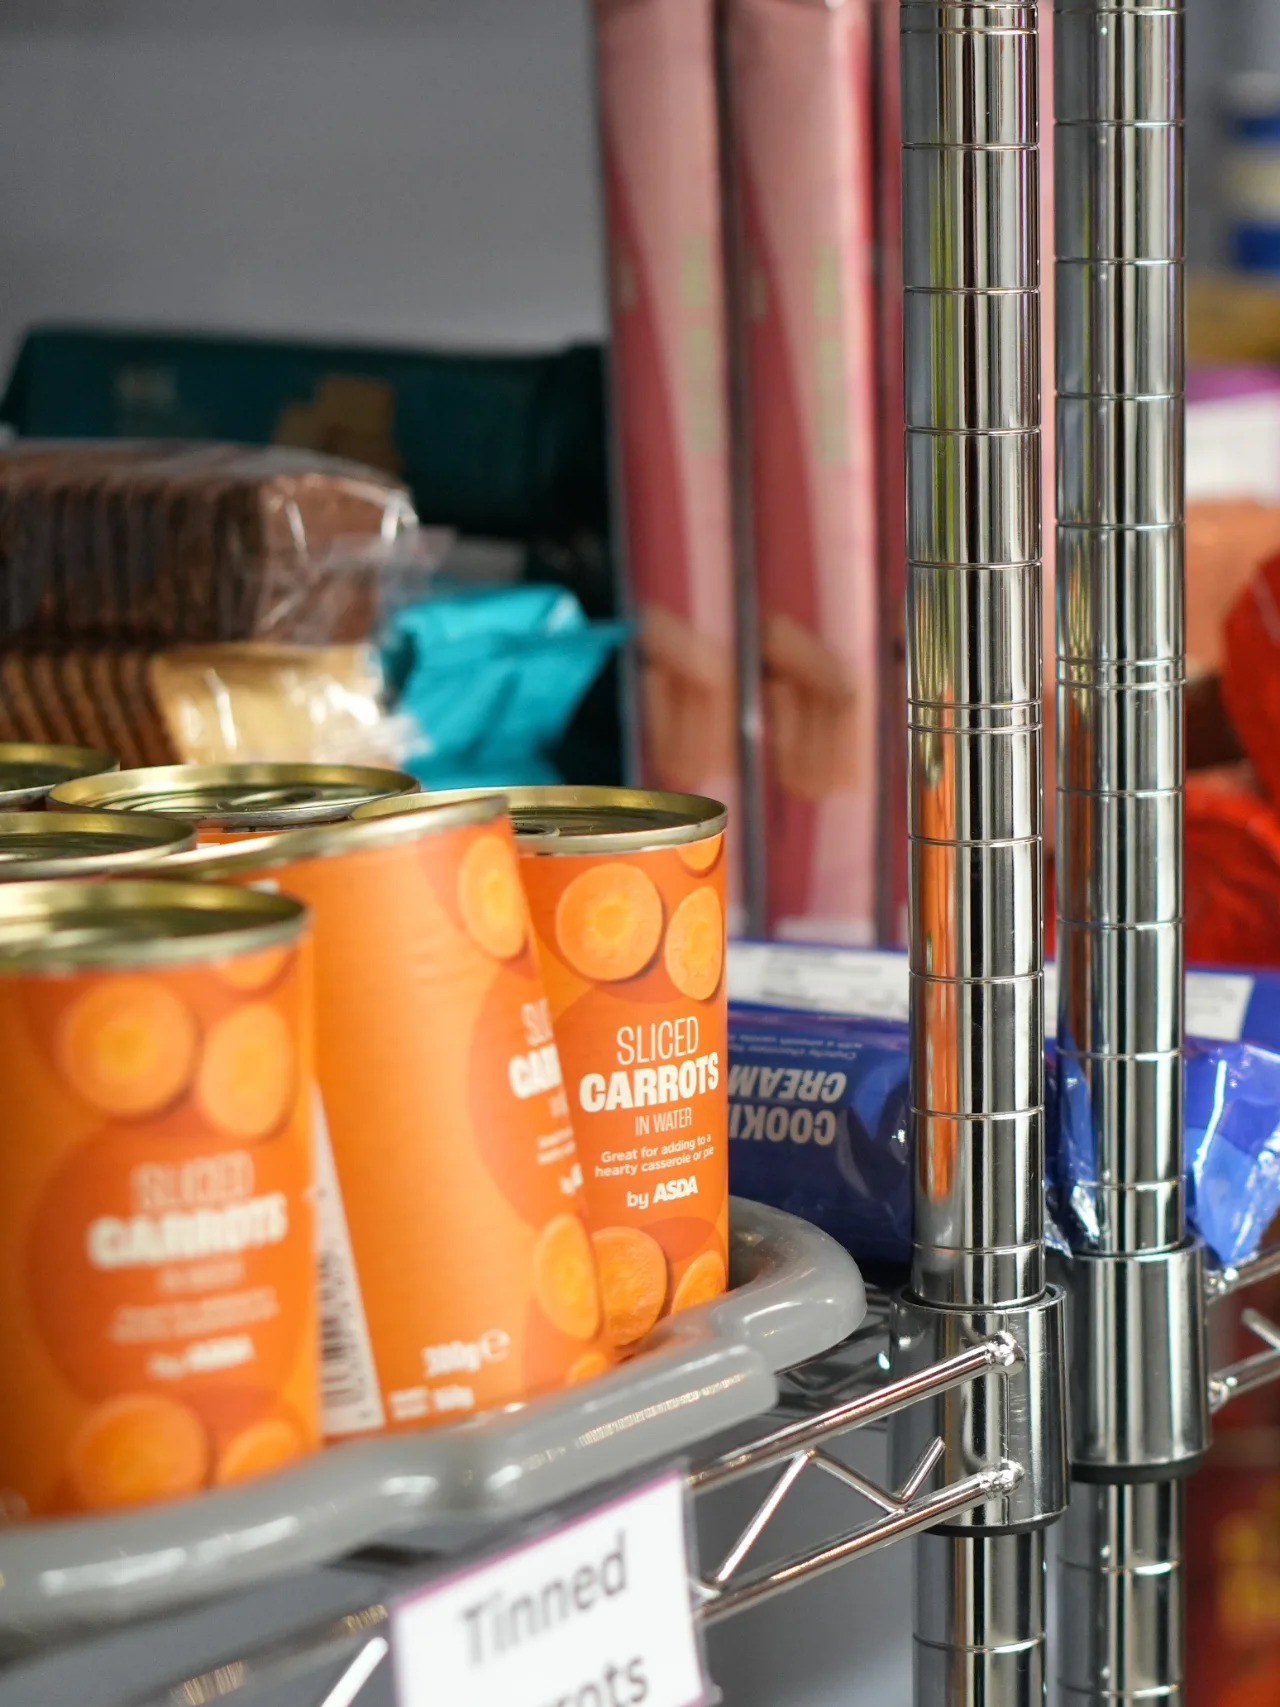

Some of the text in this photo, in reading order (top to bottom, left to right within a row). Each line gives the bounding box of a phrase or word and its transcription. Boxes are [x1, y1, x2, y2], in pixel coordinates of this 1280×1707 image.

[616, 1016, 699, 1065] SLICED
[579, 1051, 719, 1113] CARROTS
[728, 1064, 847, 1103] CREAM
[635, 1107, 692, 1136] IN WATER
[728, 1103, 836, 1147] COOKI
[594, 1145, 714, 1177] hearty casserole or pie
[601, 1133, 711, 1163] Great for adding to a
[626, 1175, 699, 1210] by ASDA
[461, 1528, 628, 1668] Tinned
